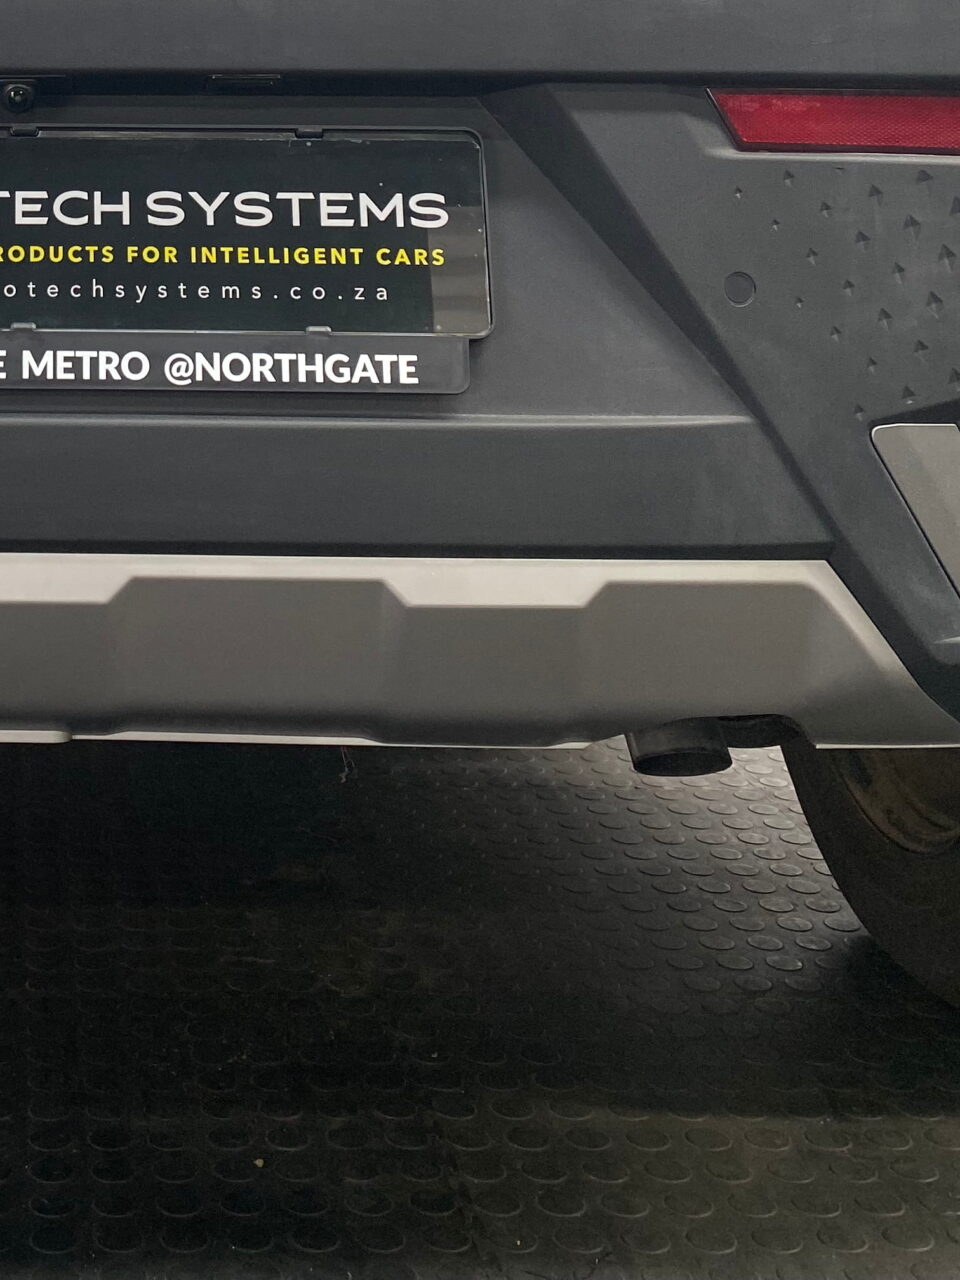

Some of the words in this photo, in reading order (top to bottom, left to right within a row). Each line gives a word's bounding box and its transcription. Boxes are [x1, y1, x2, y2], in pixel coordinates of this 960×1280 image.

[145, 190, 449, 229] SYSTEMS
[126, 245, 178, 264] FOR
[190, 245, 364, 265] INTELLIGENT
[374, 247, 446, 267] CARS
[21, 349, 151, 381] METRO
[163, 351, 420, 386] @NORTHGATE
